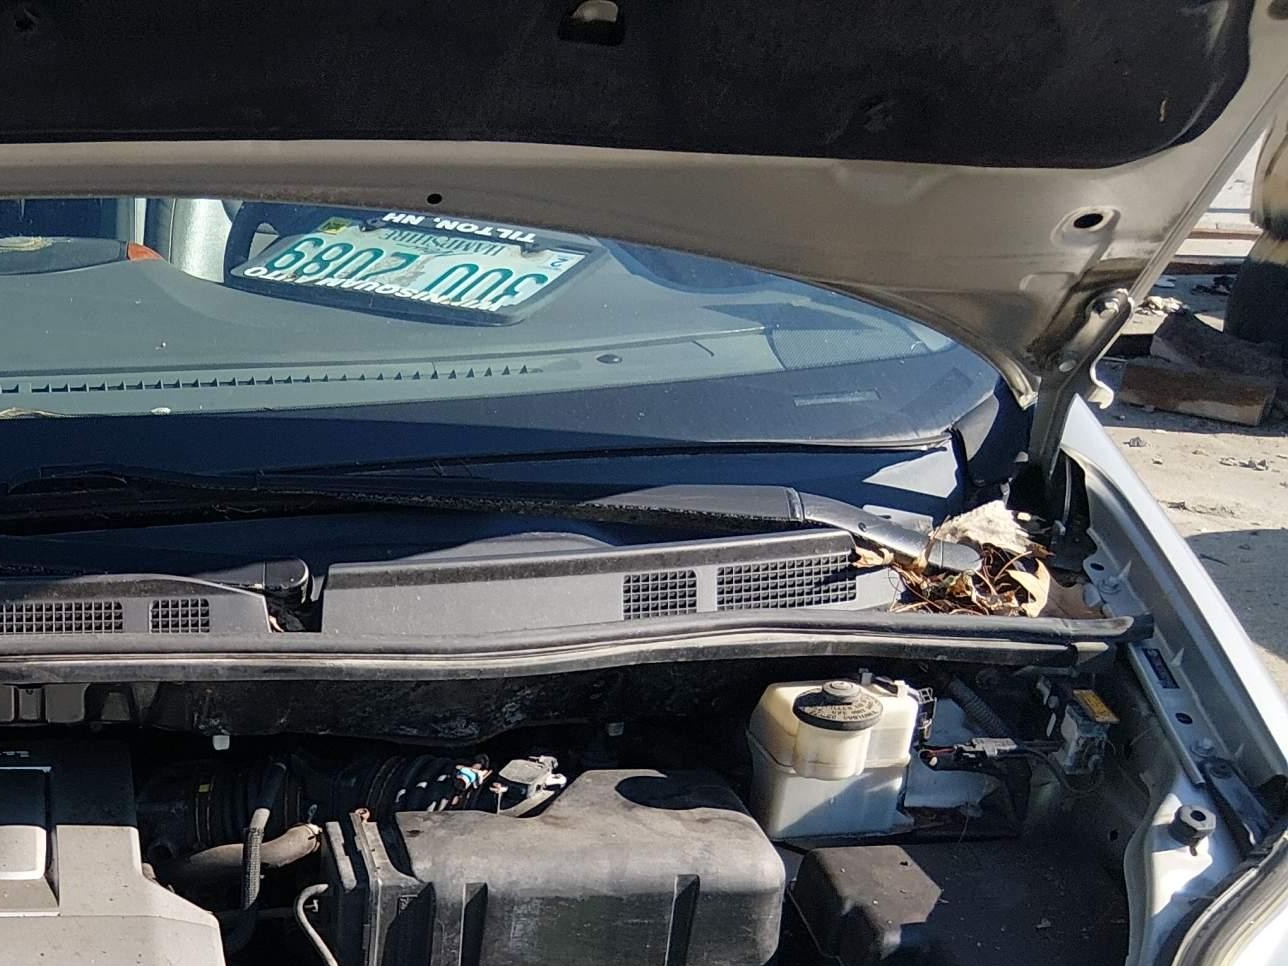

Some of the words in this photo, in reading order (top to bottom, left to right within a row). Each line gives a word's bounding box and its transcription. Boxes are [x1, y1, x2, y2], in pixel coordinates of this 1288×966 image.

[382, 212, 422, 226] NH
[433, 216, 537, 243] TILTON,
[379, 230, 508, 257] HAMPSHIRE
